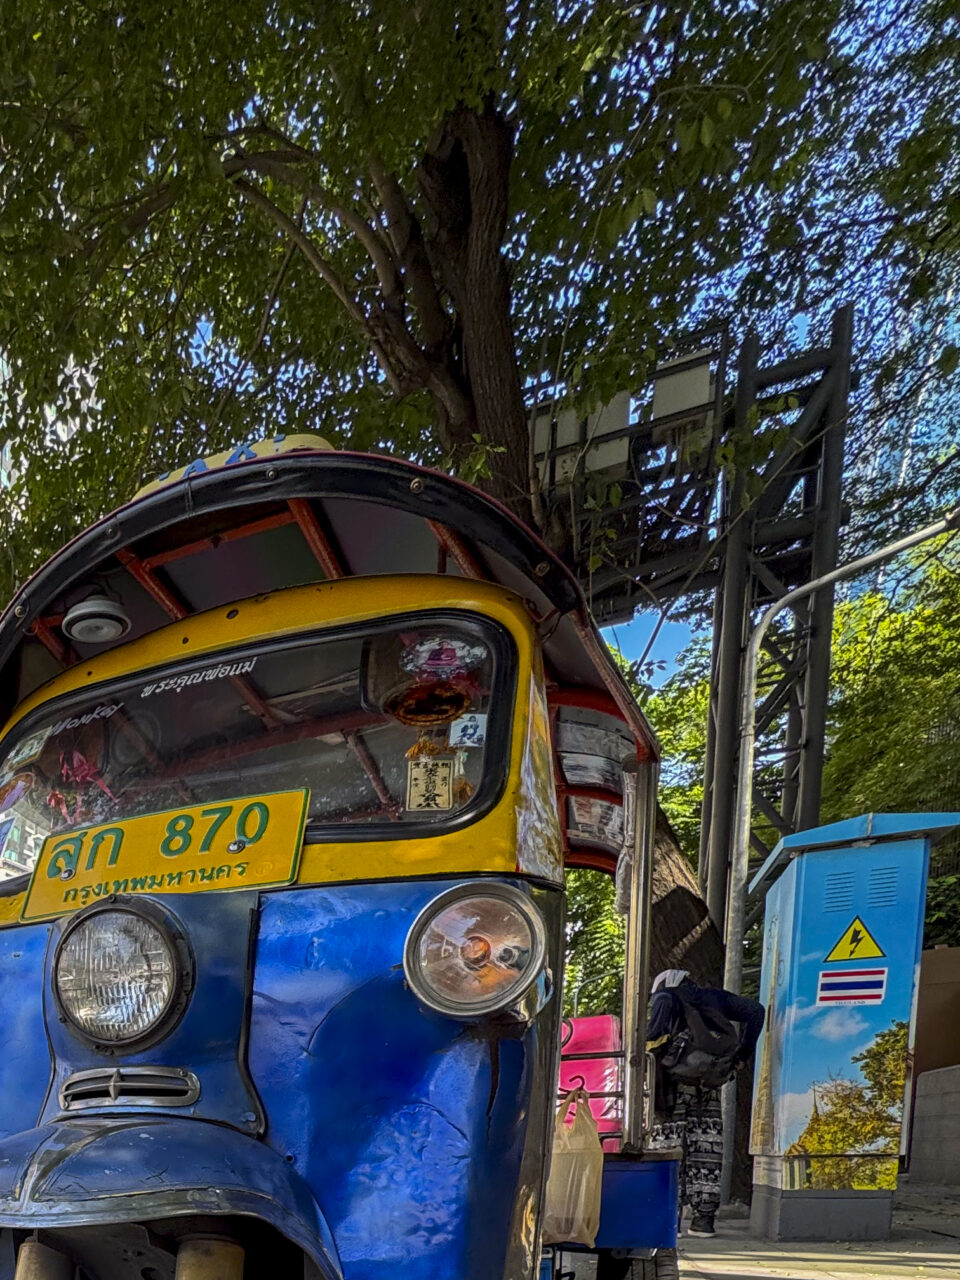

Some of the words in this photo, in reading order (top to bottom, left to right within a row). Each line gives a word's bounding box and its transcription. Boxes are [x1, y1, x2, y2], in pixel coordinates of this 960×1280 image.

[158, 433, 287, 481] AX
[141, 656, 258, 698] พระคุณพ่อแม่
[159, 801, 270, 858] 870
[63, 861, 249, 905] กรุงเทพมหานคร
